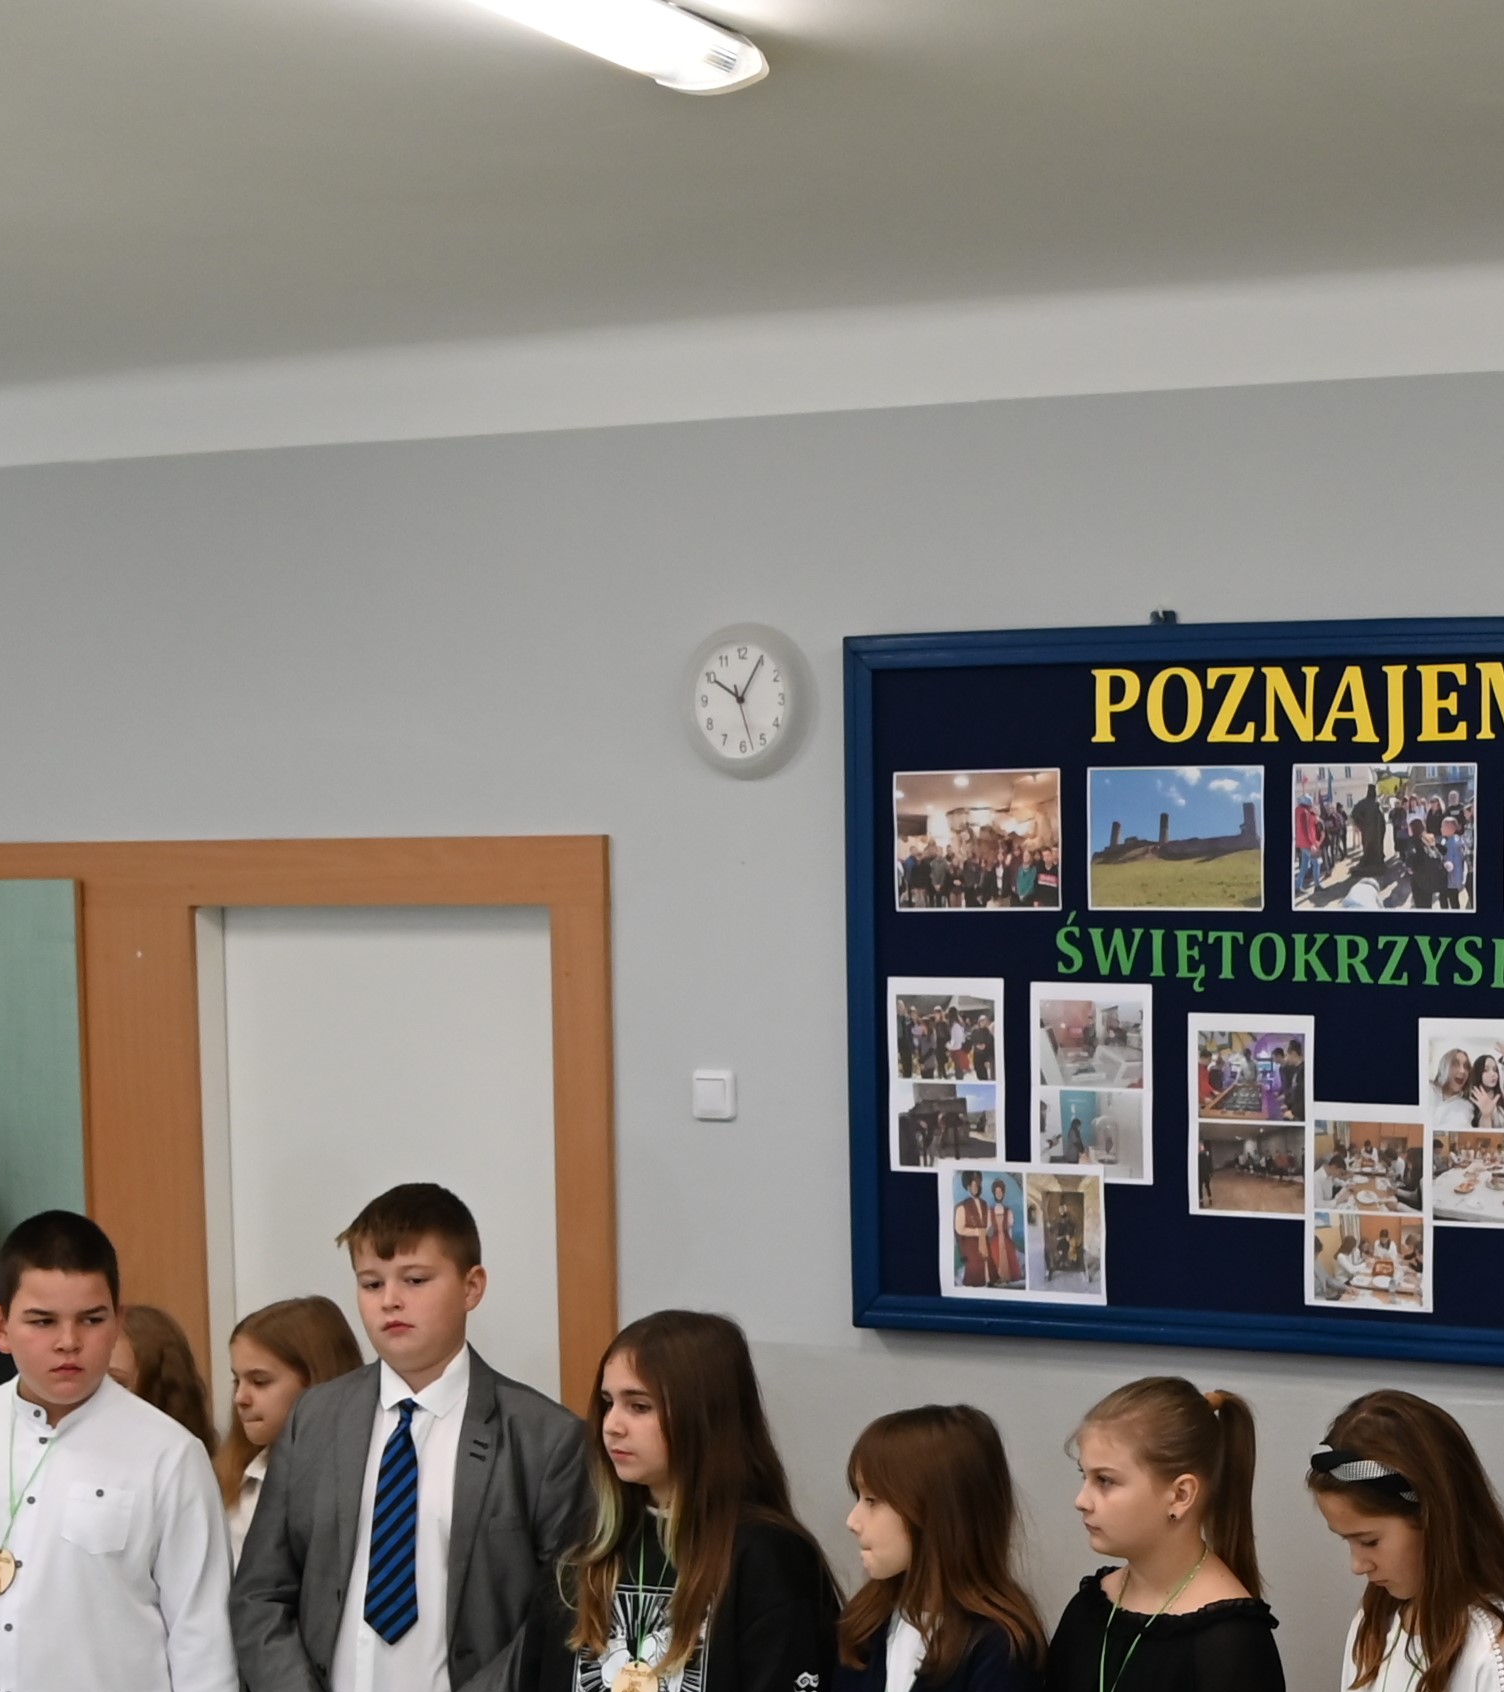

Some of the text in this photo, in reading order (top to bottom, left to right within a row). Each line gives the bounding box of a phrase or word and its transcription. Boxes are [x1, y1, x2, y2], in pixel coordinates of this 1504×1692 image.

[736, 647, 748, 660] 12
[719, 655, 728, 667] 11
[705, 671, 716, 684] 10
[773, 669, 780, 682] 2
[701, 694, 709, 707] 9
[778, 693, 785, 706] 3
[706, 718, 714, 731] 8
[772, 716, 780, 729] 4
[721, 734, 728, 746] 7
[759, 733, 767, 746] 5
[739, 740, 747, 753] 6
